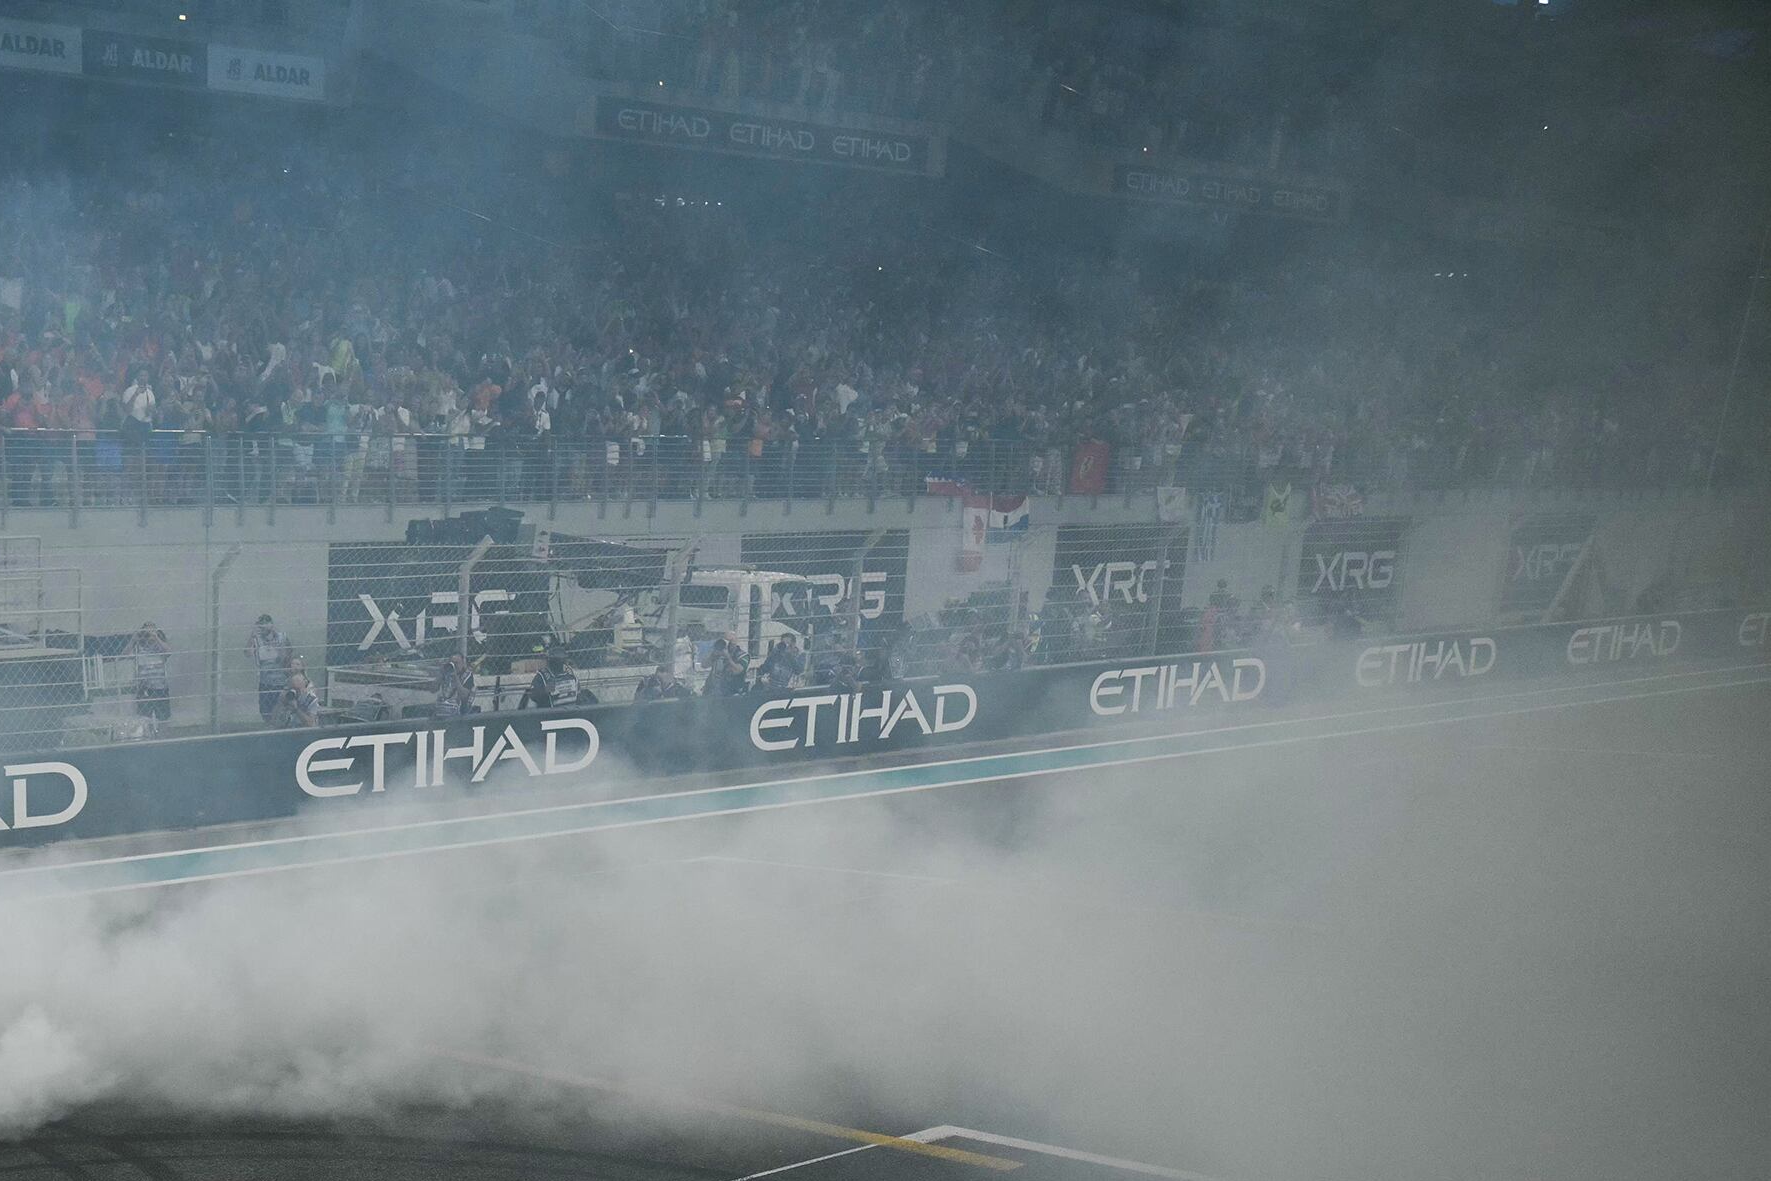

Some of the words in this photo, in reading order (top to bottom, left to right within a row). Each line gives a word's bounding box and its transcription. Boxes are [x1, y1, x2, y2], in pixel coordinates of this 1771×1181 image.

[0, 33, 66, 58] ALDAR
[132, 49, 193, 73] ALDAR
[254, 63, 310, 87] ALDAR
[618, 108, 710, 138] ETIHAD
[730, 122, 815, 151] ETIHAD
[832, 135, 911, 162] ETIHAD
[1312, 551, 1395, 593] XRG
[1355, 637, 1497, 686] ETIHAD
[1567, 620, 1681, 664] ETIHAD
[1090, 658, 1265, 715] ETIHAD
[750, 684, 977, 751] ETIHAD
[295, 718, 599, 797] ETIHAD
